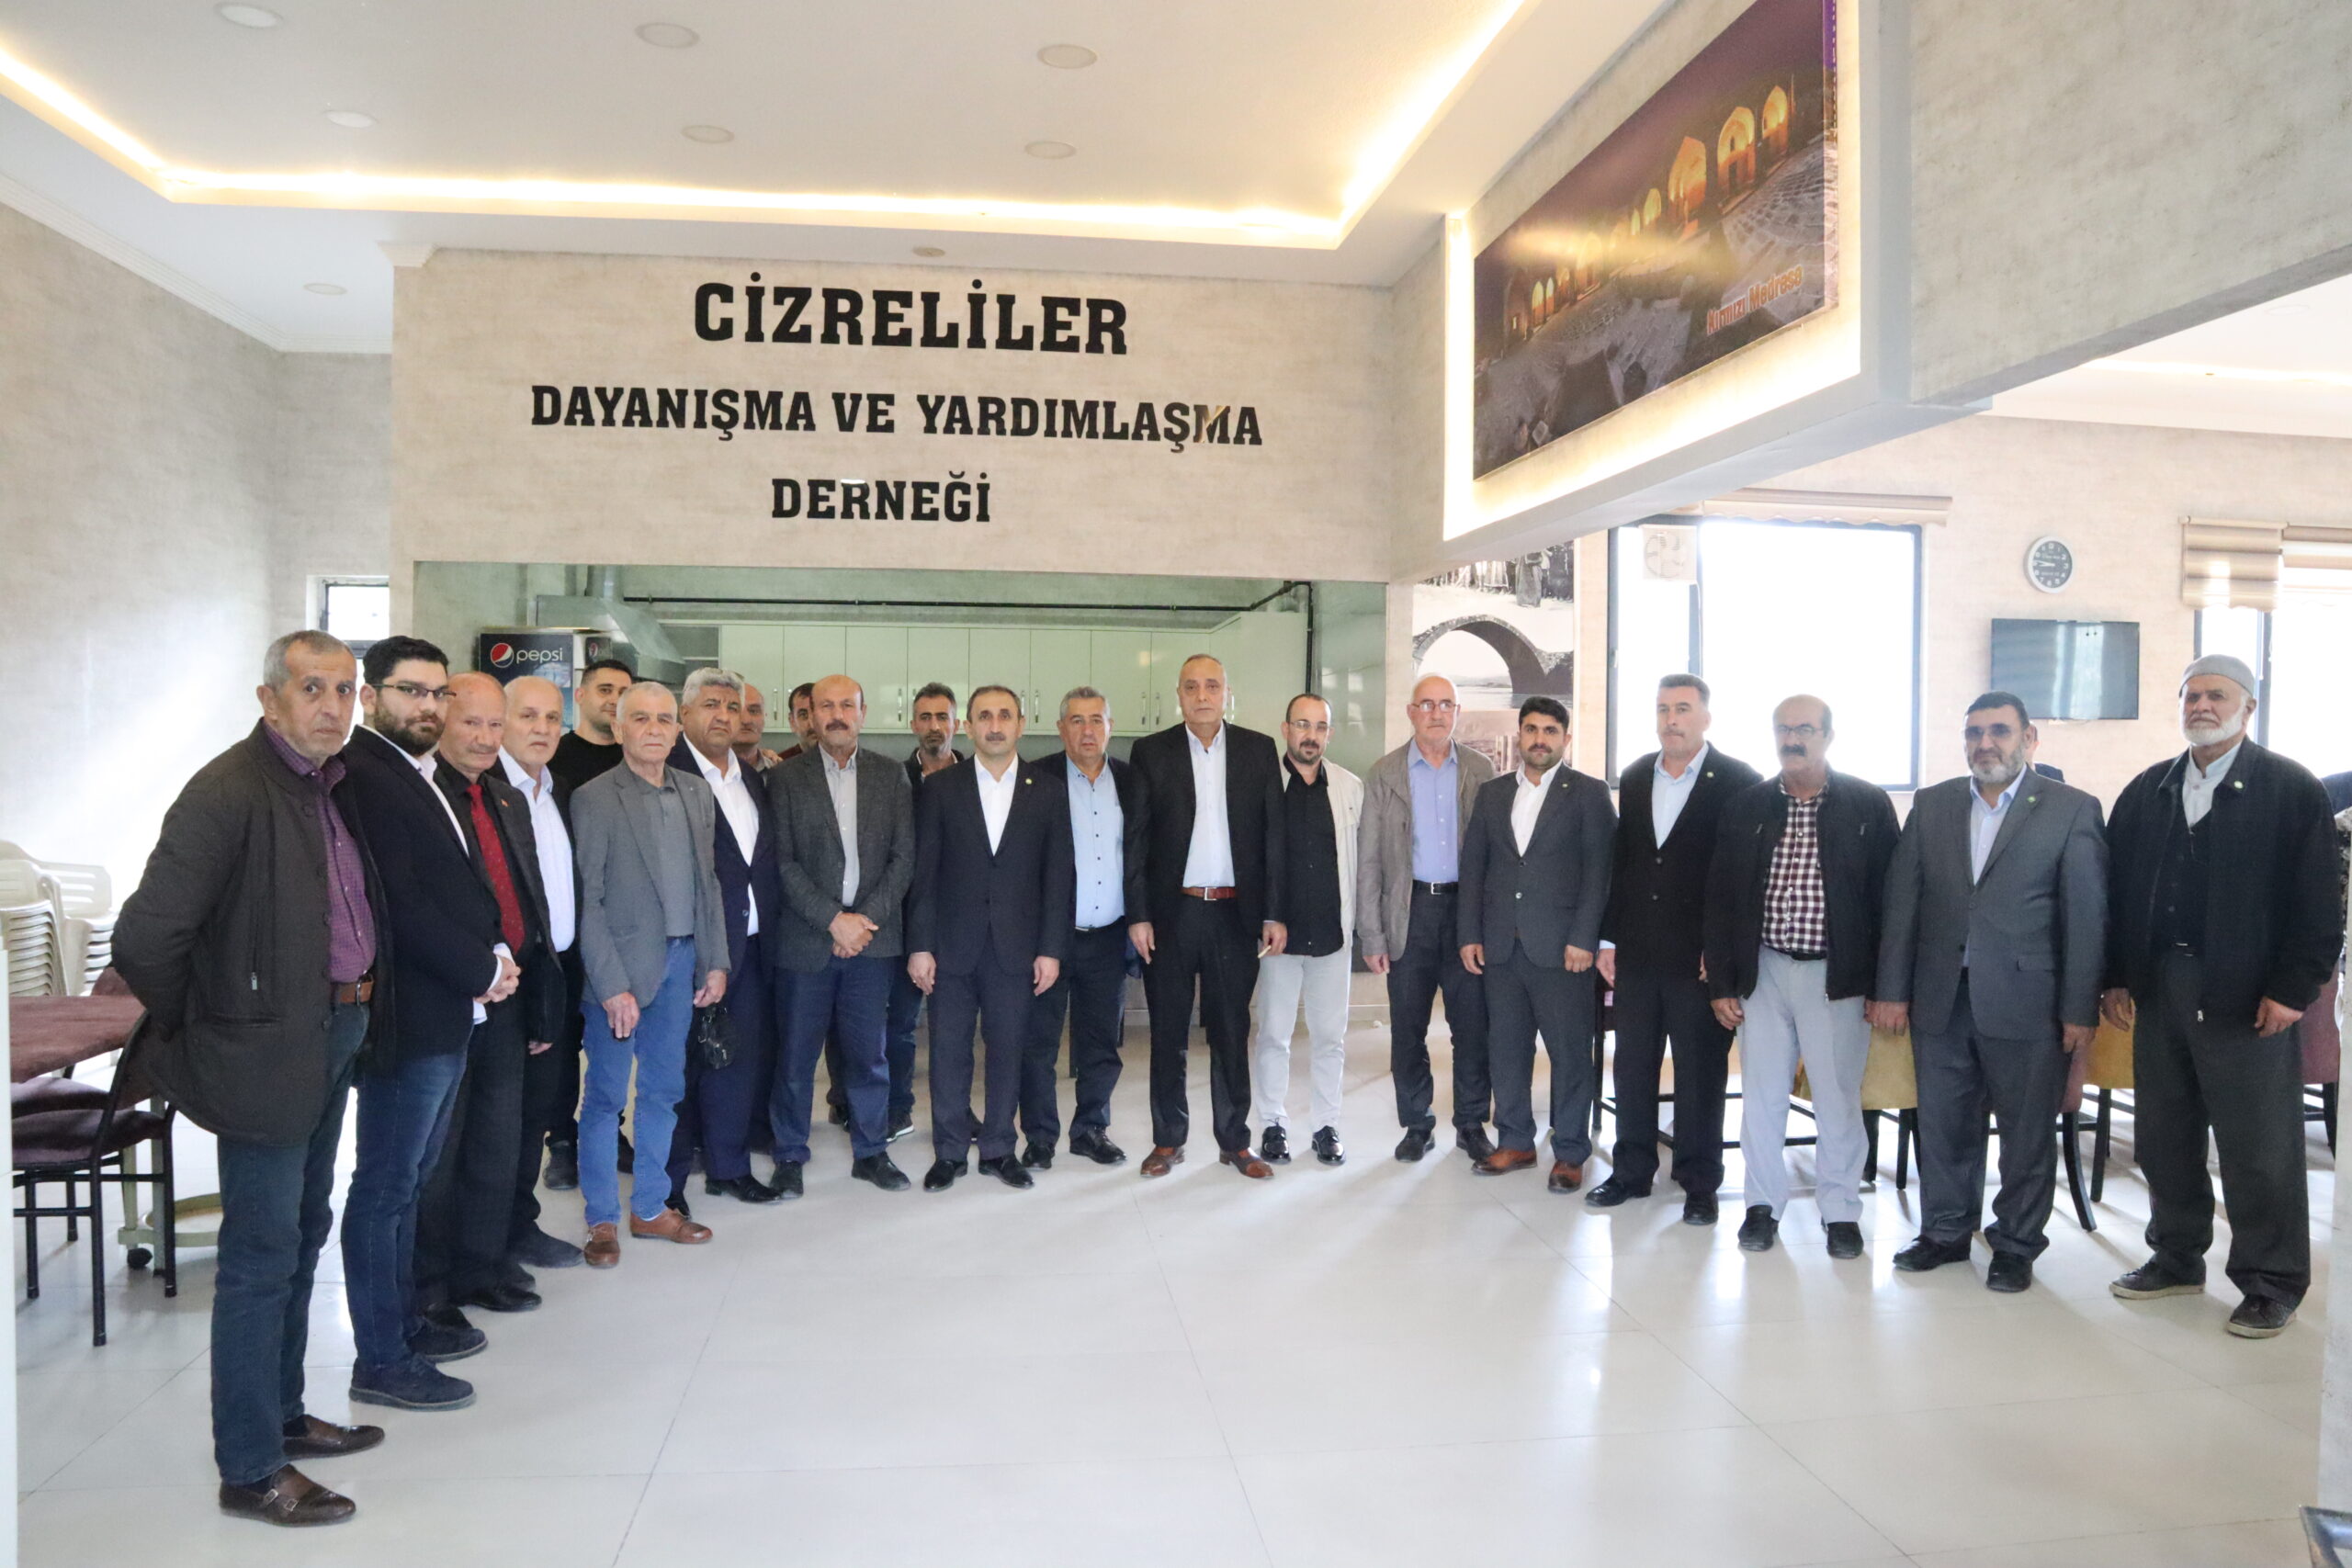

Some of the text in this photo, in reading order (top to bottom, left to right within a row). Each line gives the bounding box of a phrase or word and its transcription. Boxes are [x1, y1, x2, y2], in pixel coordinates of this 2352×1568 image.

[695, 272, 1126, 355] CİZRELİLER
[532, 386, 1262, 453] DAYANIŞMA VE YARDIMLAŞMA
[773, 471, 989, 522] DERNEĞİ
[516, 648, 563, 664] pepsi
